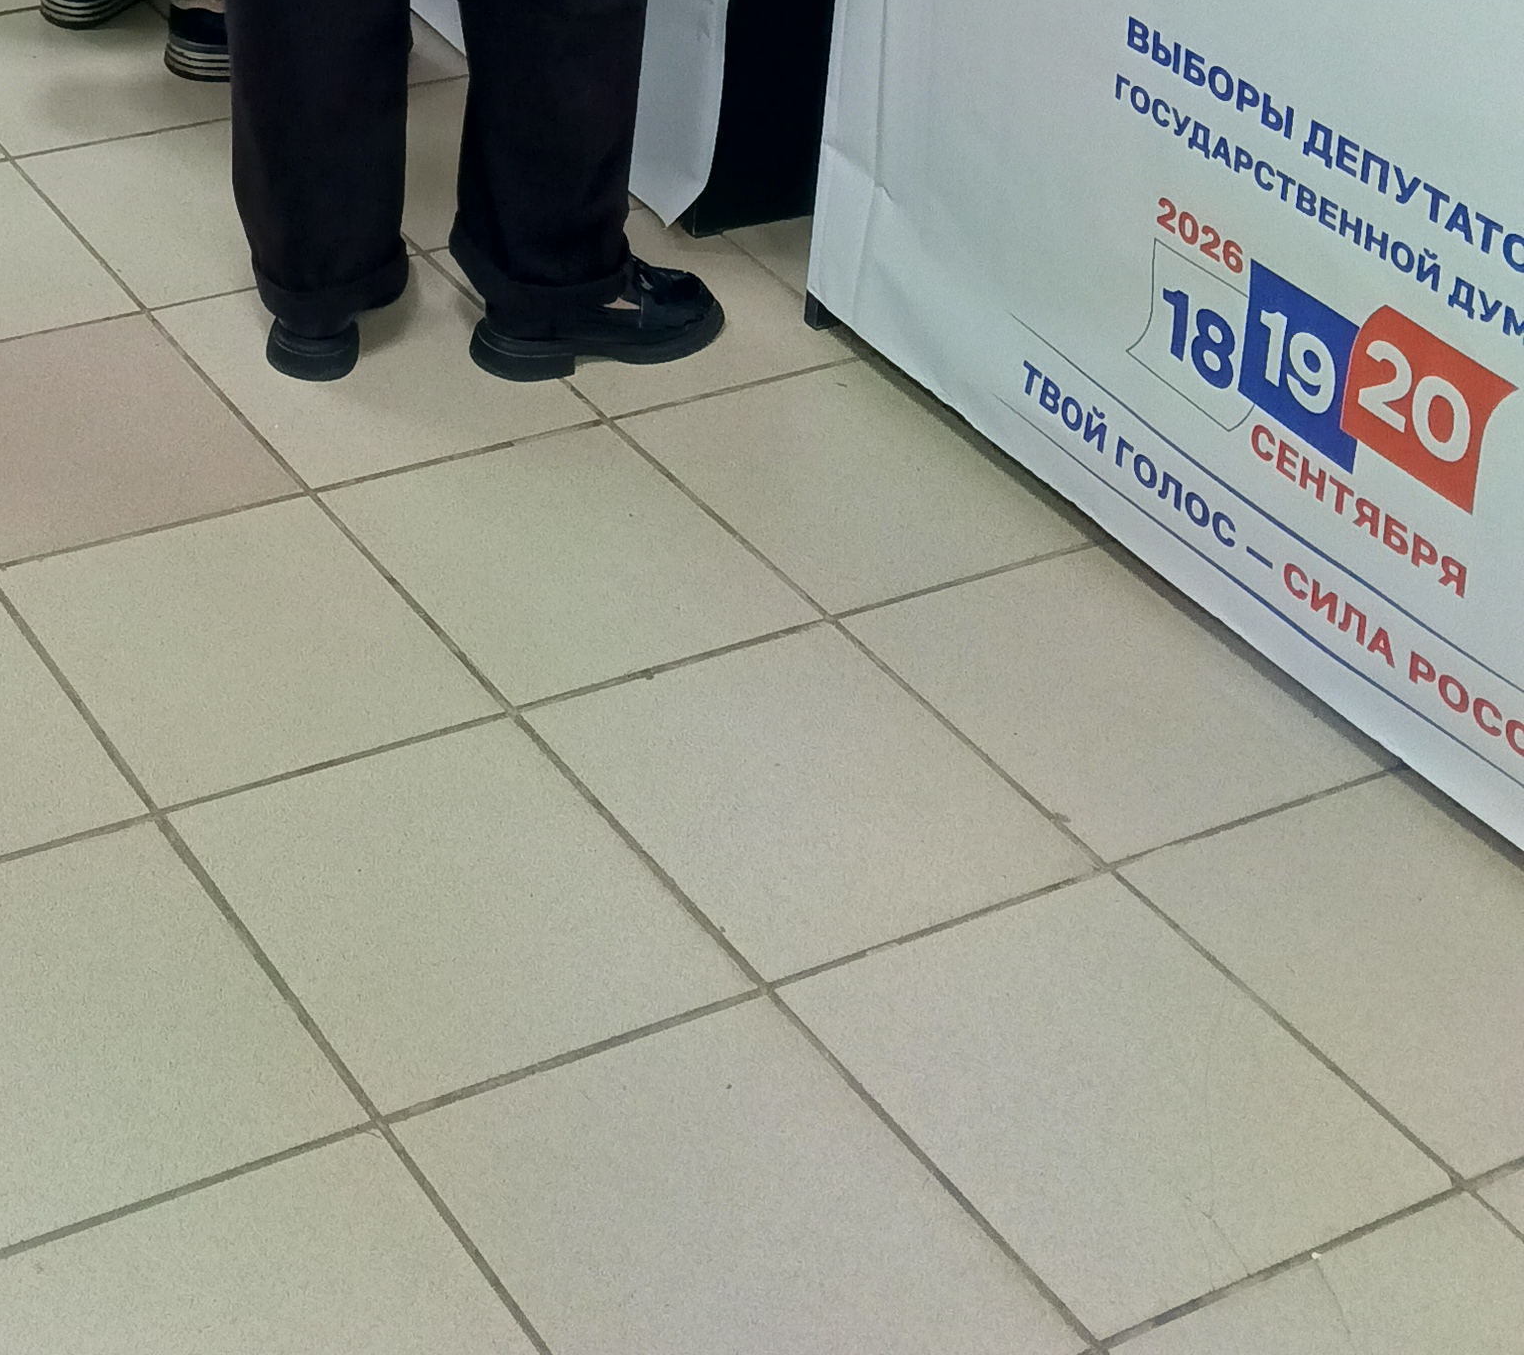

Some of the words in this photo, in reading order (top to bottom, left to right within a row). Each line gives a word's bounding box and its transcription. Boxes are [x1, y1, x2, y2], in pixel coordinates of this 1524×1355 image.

[1114, 73, 1441, 293] ГОСУДАРСТВЕННОЙ
[1448, 276, 1524, 338] ДУМ
[1127, 16, 1295, 139] ВЫБОРЫ
[1302, 120, 1524, 274] ДЕПУТАТО
[1156, 197, 1244, 274] 2026
[1162, 288, 1236, 390] 18
[1258, 311, 1336, 415] 19
[1358, 339, 1472, 464] 20
[1022, 360, 1107, 454] ТВОЙ
[1115, 436, 1237, 548] ГОЛОС
[1282, 562, 1396, 669] СИЛА
[1250, 423, 1468, 600] СЕНТЯБРЯ
